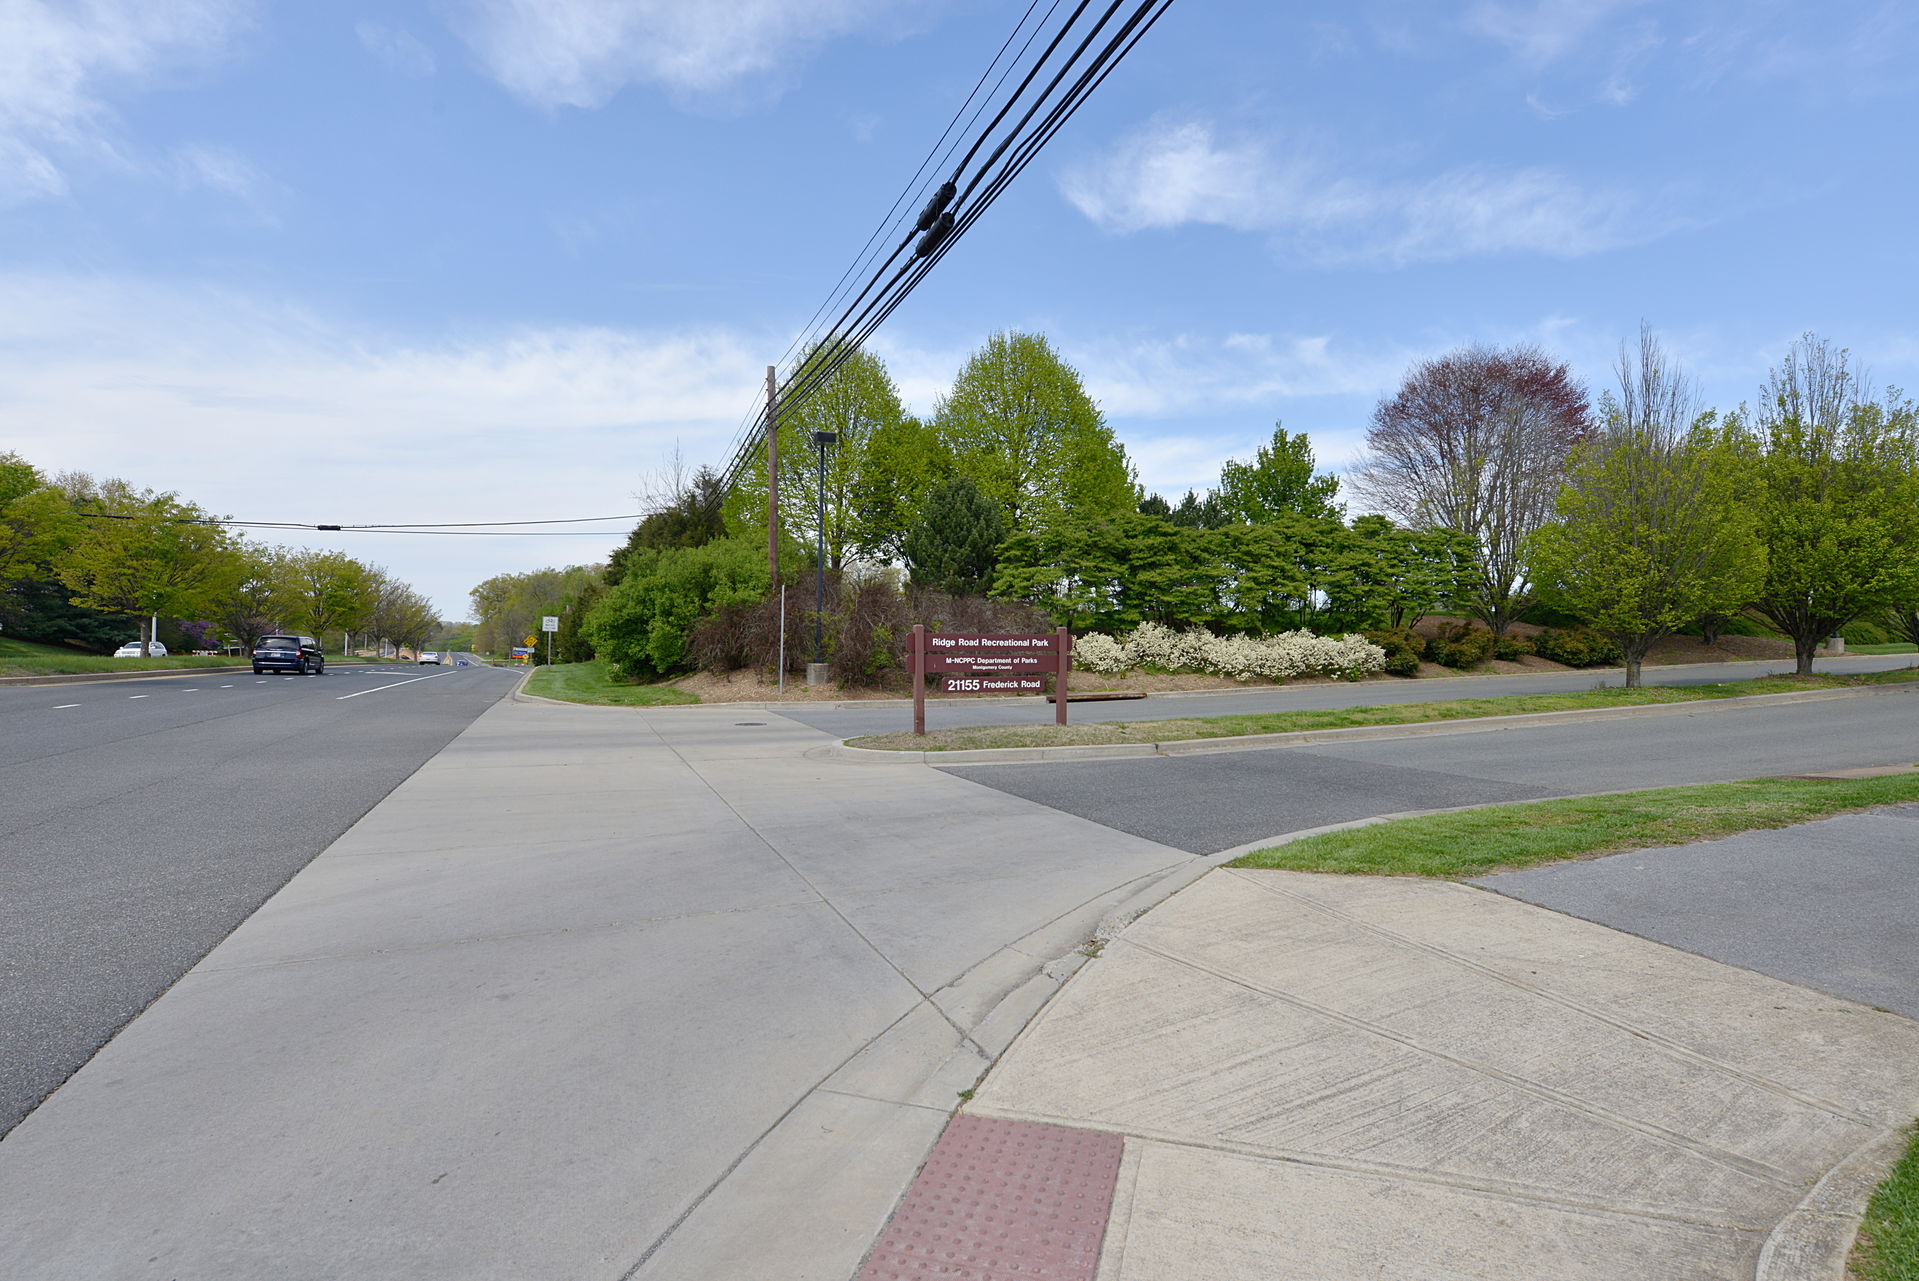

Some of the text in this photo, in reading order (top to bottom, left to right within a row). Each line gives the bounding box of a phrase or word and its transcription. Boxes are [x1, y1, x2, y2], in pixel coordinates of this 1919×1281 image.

[932, 638, 1049, 648] Ridge Road Recreational Park
[947, 679, 1041, 691] 21155 Frederick Road
